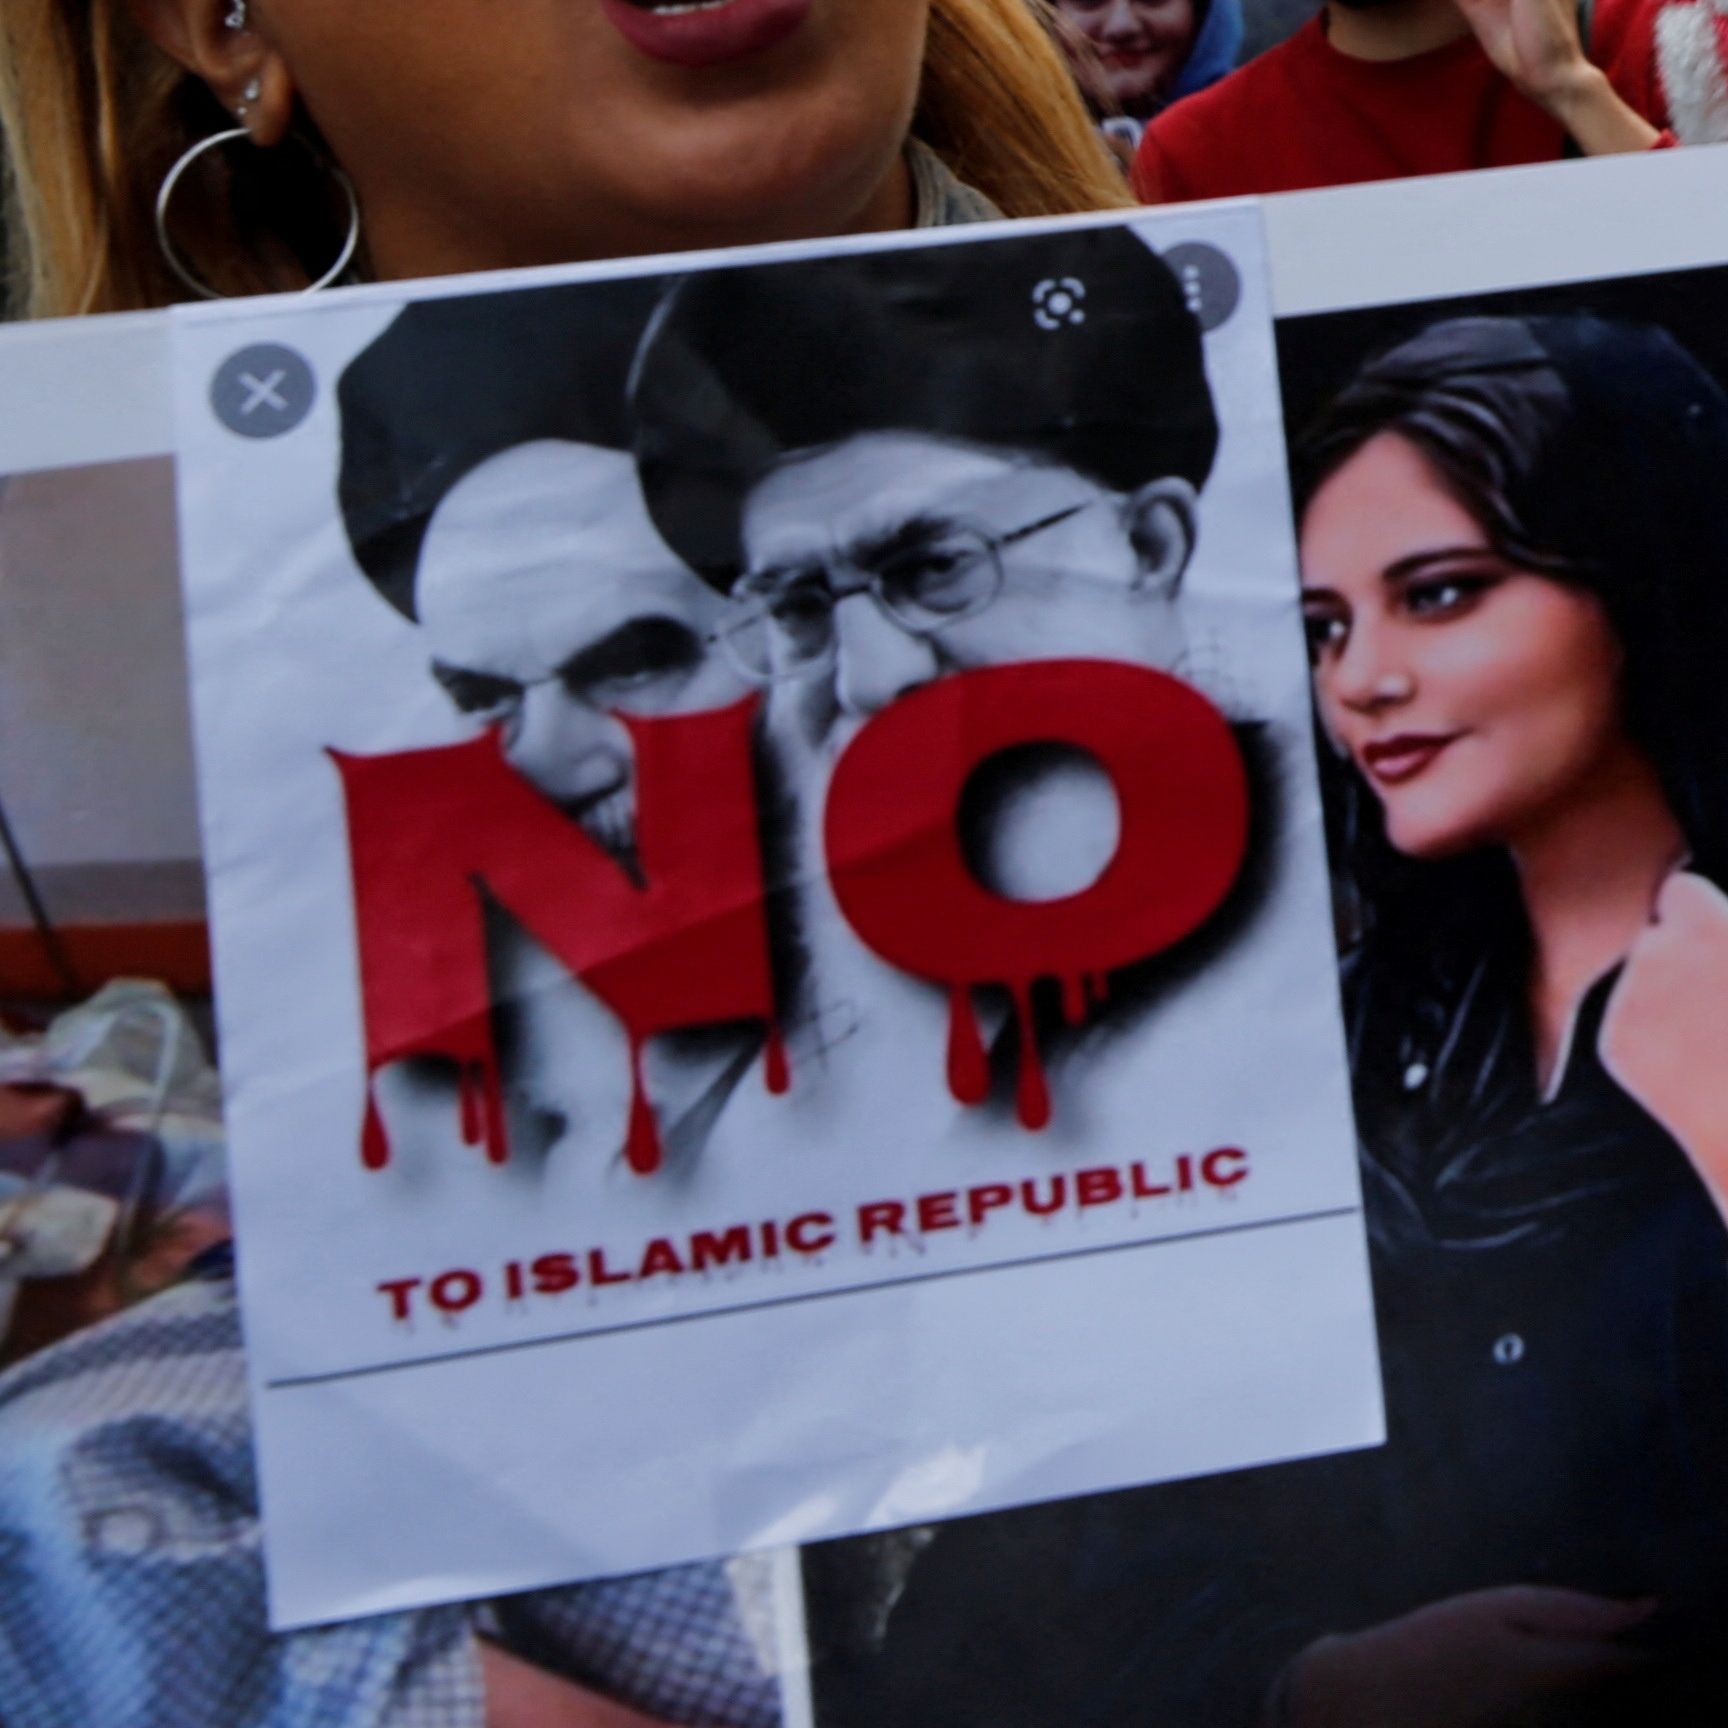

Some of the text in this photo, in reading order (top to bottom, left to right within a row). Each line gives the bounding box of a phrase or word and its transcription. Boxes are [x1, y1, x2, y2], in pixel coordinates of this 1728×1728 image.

[323, 656, 1251, 1176] NO
[377, 1145, 1252, 1323] TO ISLAMIC REPUBLIC
